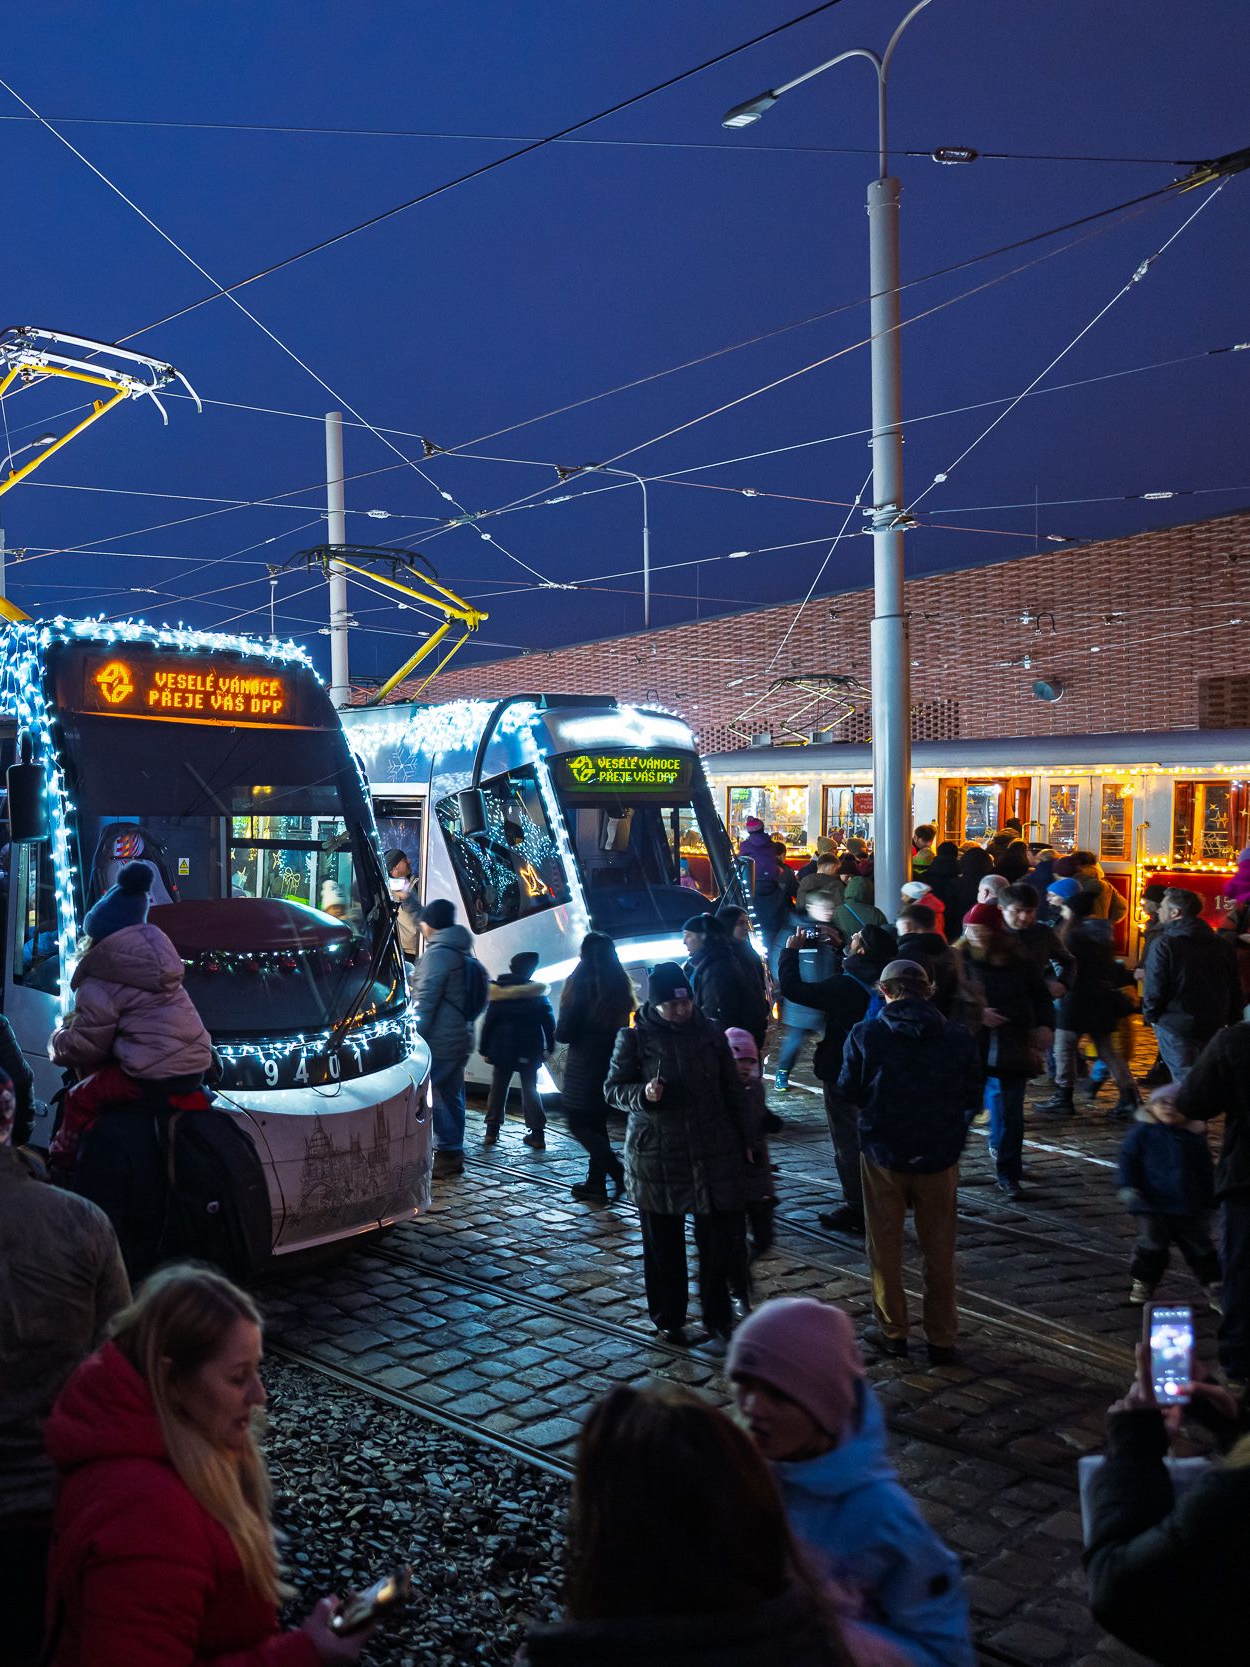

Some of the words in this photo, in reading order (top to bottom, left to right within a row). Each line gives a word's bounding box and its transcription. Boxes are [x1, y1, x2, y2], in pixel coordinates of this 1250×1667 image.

[155, 672, 215, 691] VESELÉ
[218, 676, 278, 696] VÁNOCE
[149, 688, 204, 709] PŘEJE
[210, 693, 245, 712] VÁŠ
[251, 699, 283, 714] DPP
[639, 757, 681, 770] VÁNOCE
[599, 769, 632, 782] PŘEJE
[633, 770, 655, 782] VÁŠ
[657, 772, 678, 783] DPP
